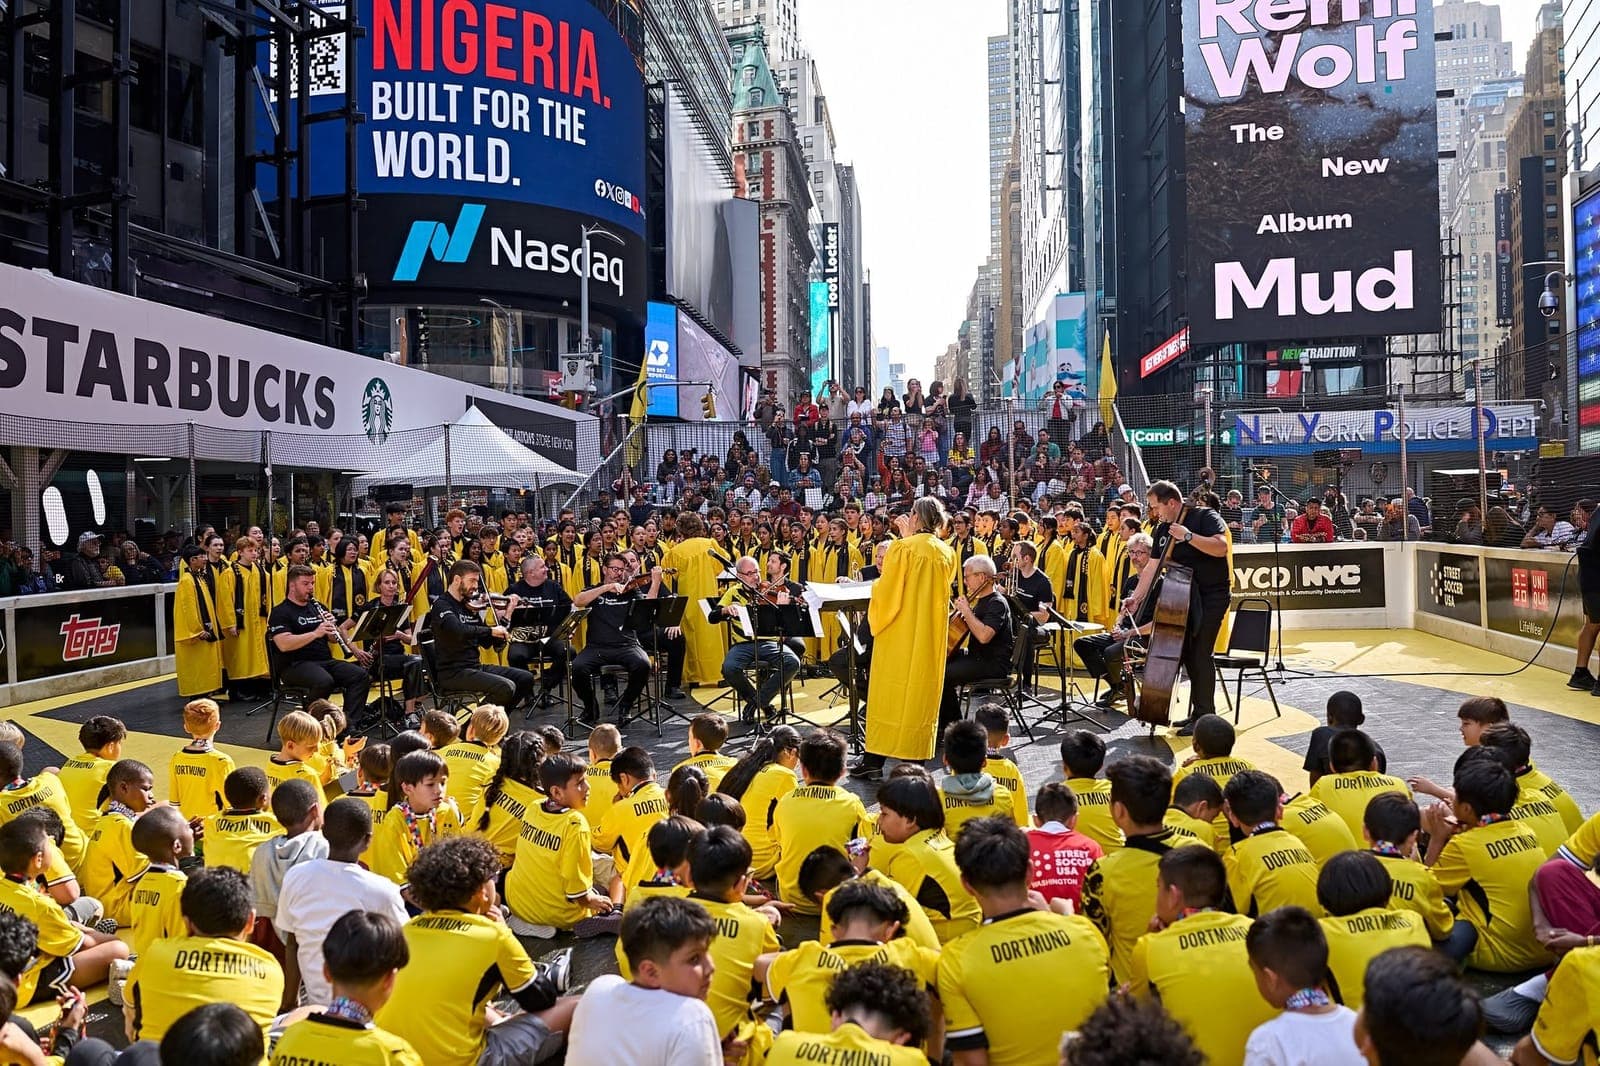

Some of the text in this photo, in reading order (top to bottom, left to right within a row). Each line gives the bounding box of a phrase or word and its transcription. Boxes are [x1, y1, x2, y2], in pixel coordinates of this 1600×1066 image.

[372, 0, 611, 109] NIGERIA.
[1198, 19, 1418, 98] Wolf
[372, 81, 586, 146] BUILT FOR THE
[1230, 123, 1284, 144] The
[372, 130, 521, 186] WORLD.
[1321, 156, 1389, 177] New
[1256, 213, 1352, 234] Album
[491, 227, 624, 296] Nasdaq
[825, 226, 838, 307] Foot Locker
[1214, 250, 1414, 320] Mud
[1303, 346, 1357, 359] TRADITION
[0, 308, 335, 430] STARBUCKS
[1374, 410, 1460, 440] POLICE
[1471, 407, 1541, 439] DEPT
[1302, 564, 1360, 587] NYC
[1443, 565, 1461, 580] STREET
[1532, 575, 1545, 590] UNI
[1324, 587, 1360, 596] Development
[1443, 580, 1464, 595] SOCCER
[1444, 595, 1456, 608] USA
[1533, 591, 1546, 608] QLO
[1519, 620, 1544, 636] LifeWear
[446, 749, 485, 763] DORTMUND
[792, 787, 836, 799] DORTMUND
[1335, 776, 1394, 790] DORTMUND
[8, 787, 53, 815] DORTMUND
[1054, 850, 1090, 858] STREET
[1056, 867, 1079, 876] USA
[1031, 878, 1078, 888] WASHINGTON
[1347, 913, 1411, 934] DORTMUND
[990, 929, 1071, 963] DORTMUND
[1179, 926, 1248, 951] DORTMUND
[175, 950, 267, 980] DORTMUND
